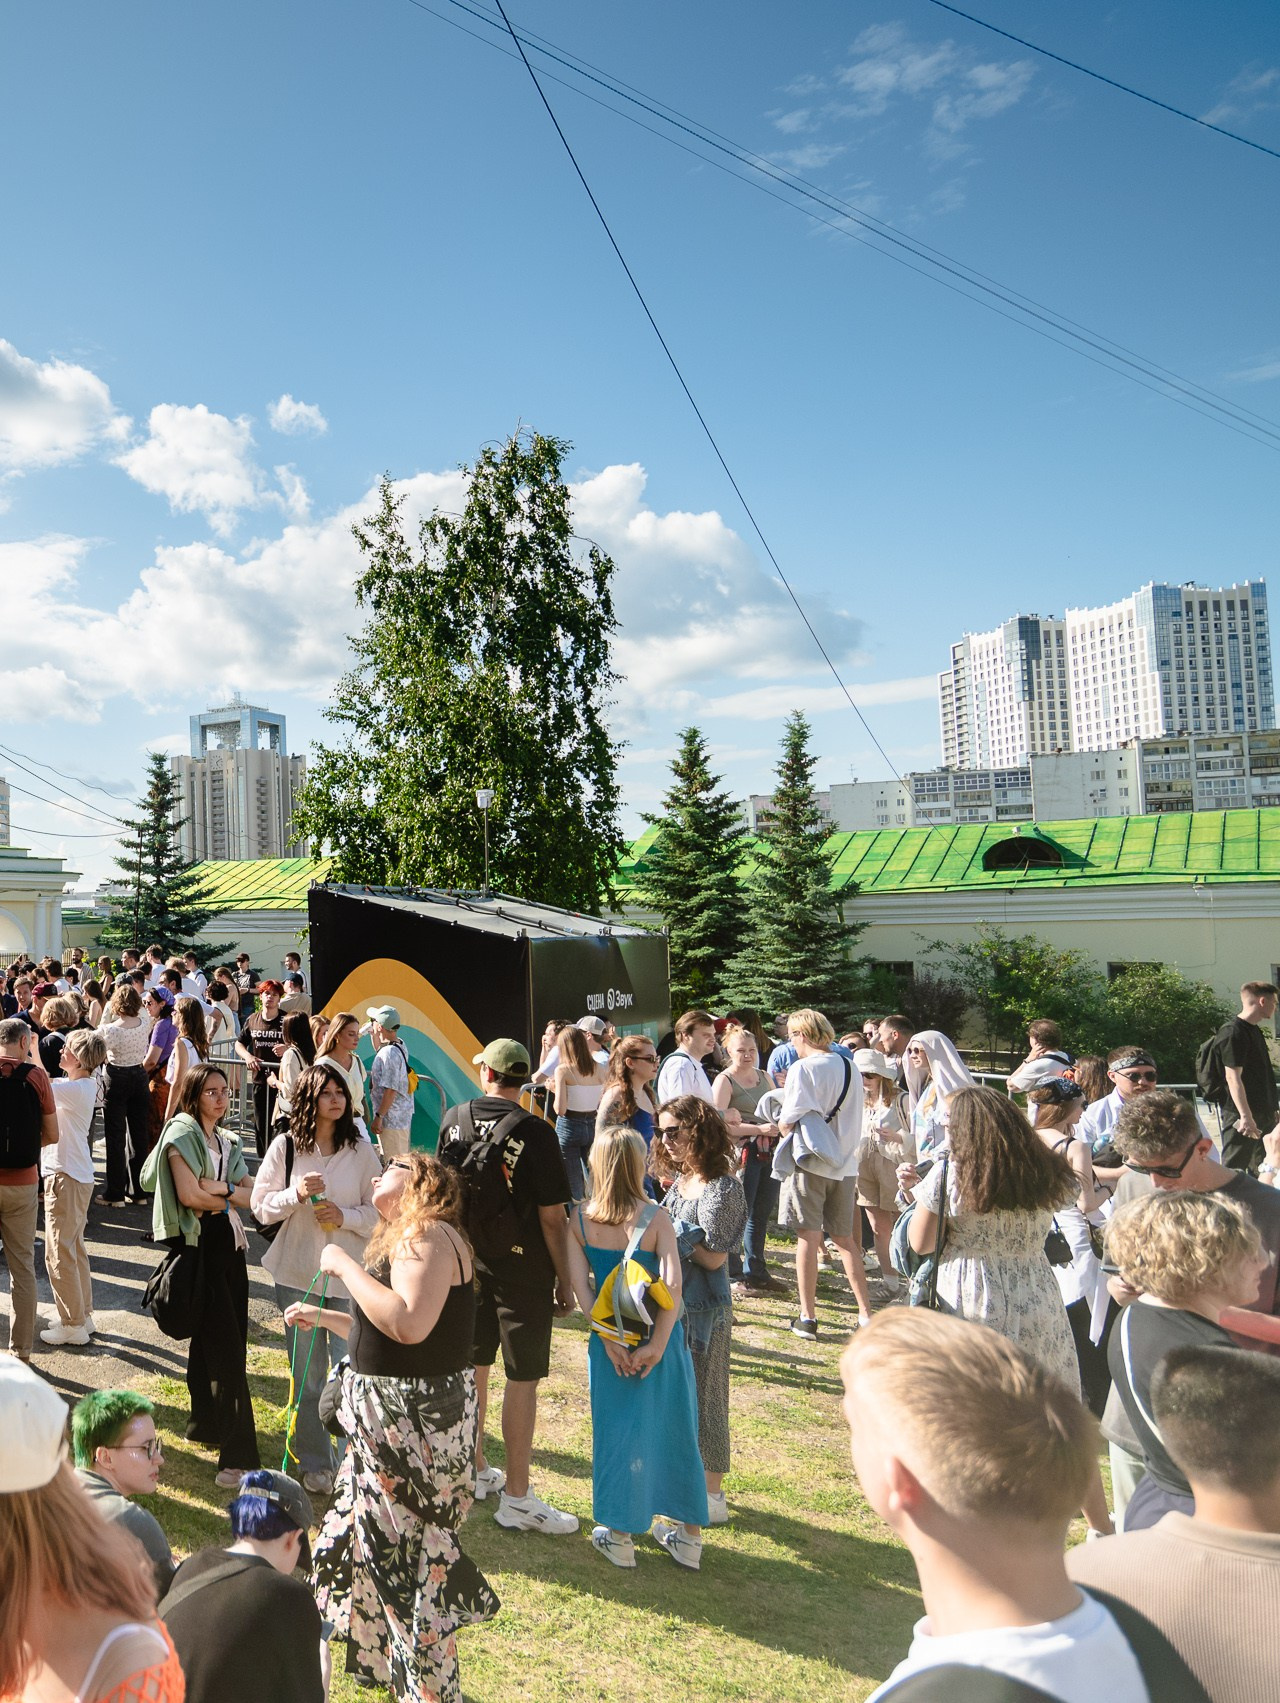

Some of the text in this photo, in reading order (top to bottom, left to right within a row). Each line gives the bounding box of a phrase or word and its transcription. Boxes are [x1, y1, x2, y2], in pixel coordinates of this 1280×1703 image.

[586, 990, 633, 1012] СЦЕНА Звук
[250, 1030, 283, 1039] ECURIT
